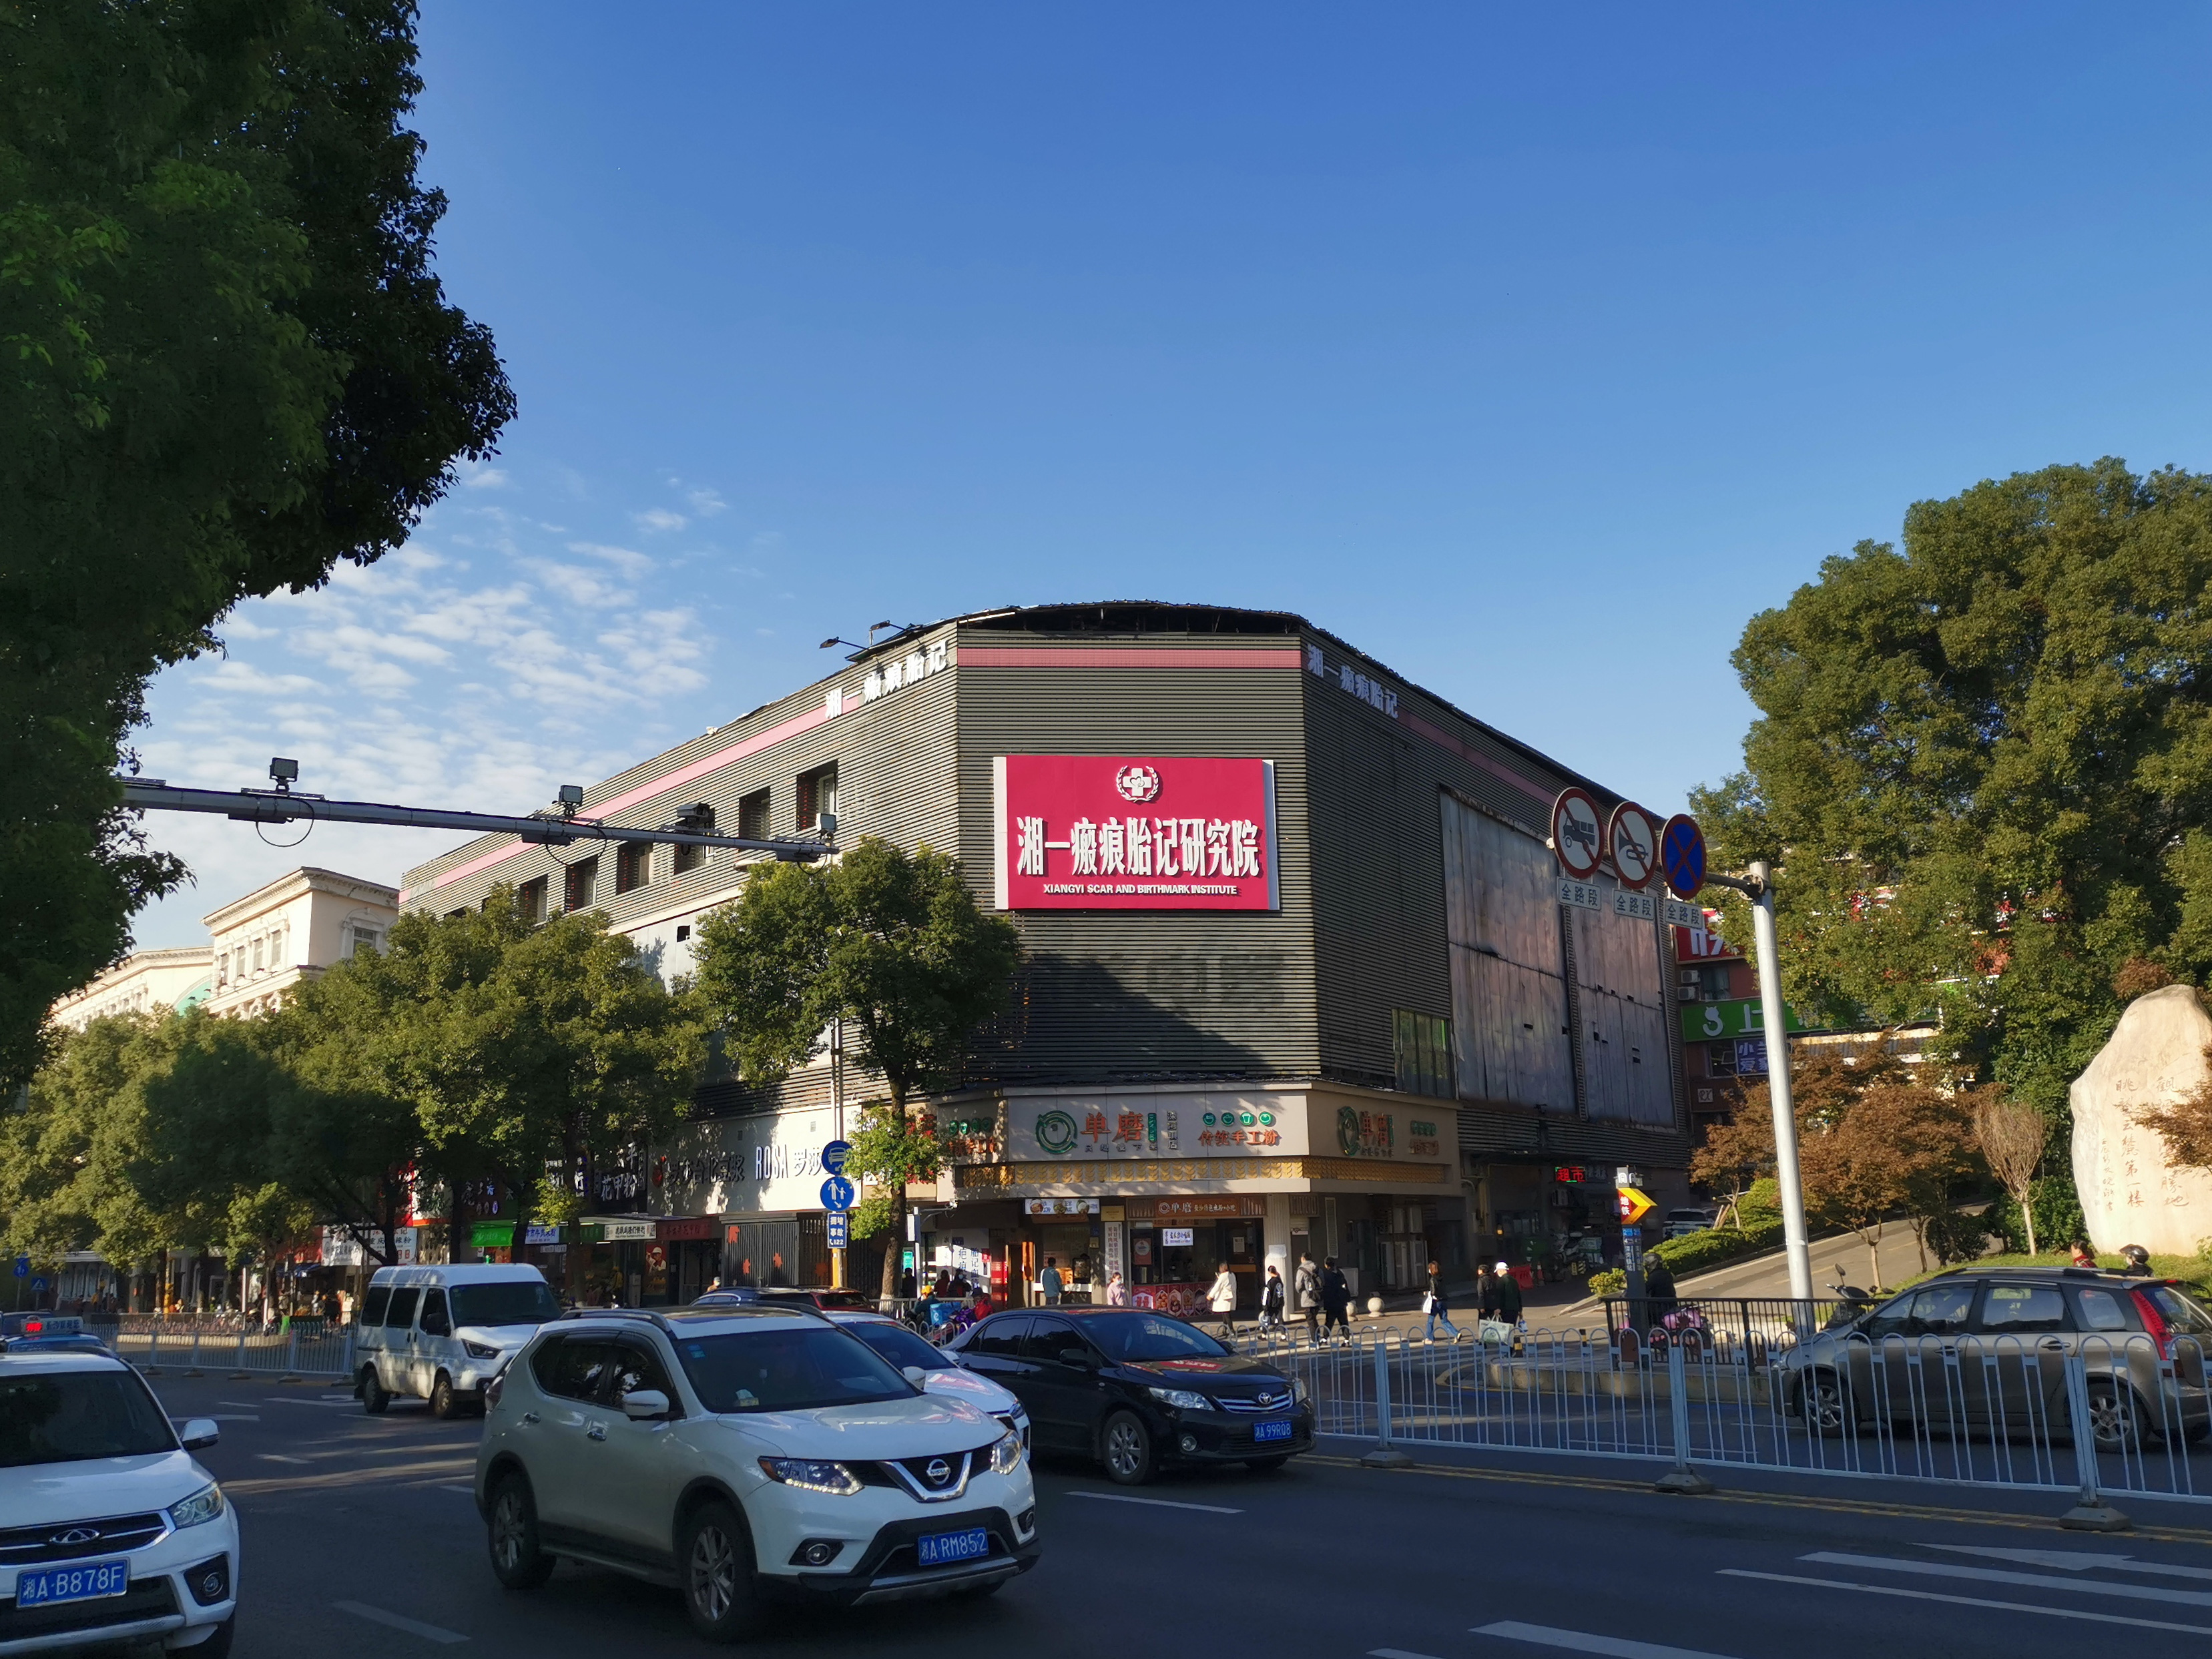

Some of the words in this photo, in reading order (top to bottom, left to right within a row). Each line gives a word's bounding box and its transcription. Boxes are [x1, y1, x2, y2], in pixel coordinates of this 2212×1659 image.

[1017, 816, 1259, 878] 湘一瘢痕胎记研究院
[1043, 884, 1084, 894] XIANGYI
[1087, 884, 1113, 894] SCAR
[1115, 884, 1135, 894] AND
[1137, 884, 1190, 894] BIRTHMARK
[1191, 885, 1237, 895] INSTITUTE
[1561, 884, 1599, 907] 全路段
[1616, 894, 1651, 916] 全路段
[1667, 904, 1700, 926] 全路段
[1080, 1111, 1144, 1143] 单磨
[1198, 1129, 1278, 1146] 传统手工粉
[756, 1144, 789, 1181] ROSA
[1557, 1167, 1585, 1182] 超市
[1620, 1197, 1631, 1216] 地铁
[370, 1236, 412, 1245] 重庆辣粉
